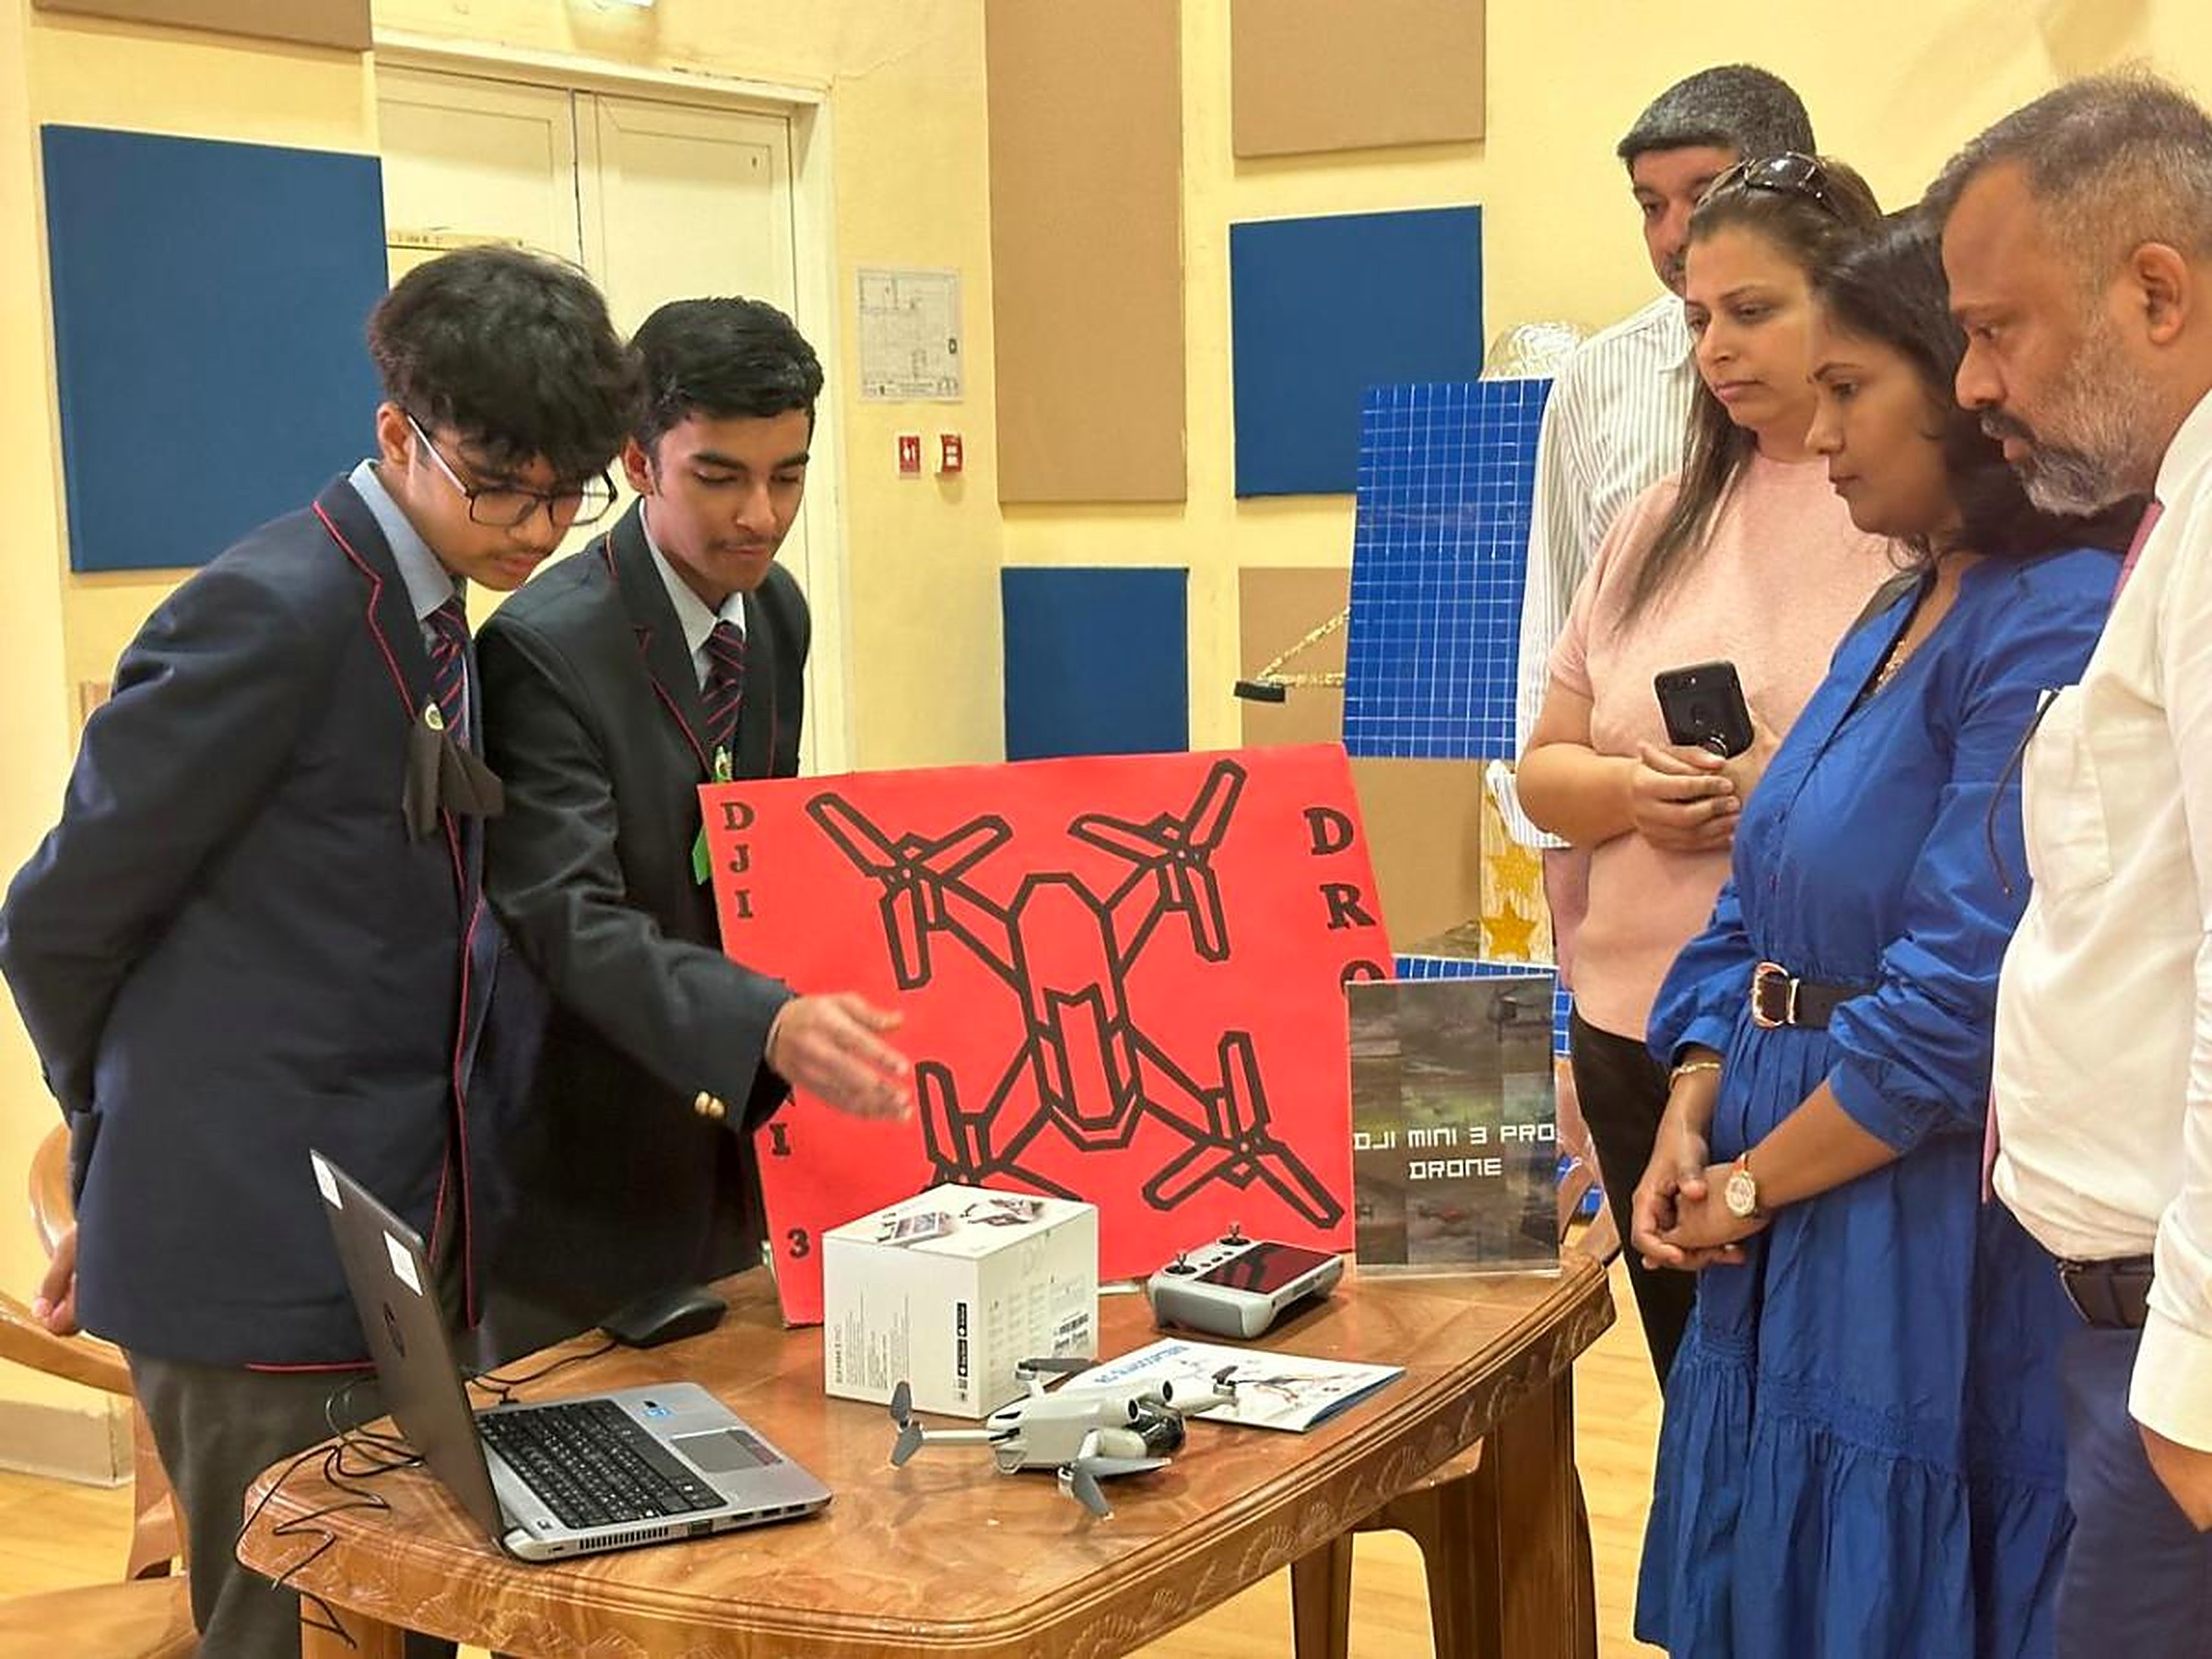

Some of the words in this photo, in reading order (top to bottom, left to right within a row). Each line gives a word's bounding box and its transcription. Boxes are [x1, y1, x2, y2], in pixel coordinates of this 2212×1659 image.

[720, 801, 755, 919] DJI
[1354, 1131, 1396, 1151] DJI
[1408, 1127, 1457, 1148] MINI
[1469, 1126, 1488, 1145] 3
[1500, 1123, 1556, 1144] PRO
[1409, 1158, 1502, 1180] DRONE
[786, 1229, 810, 1260] 3
